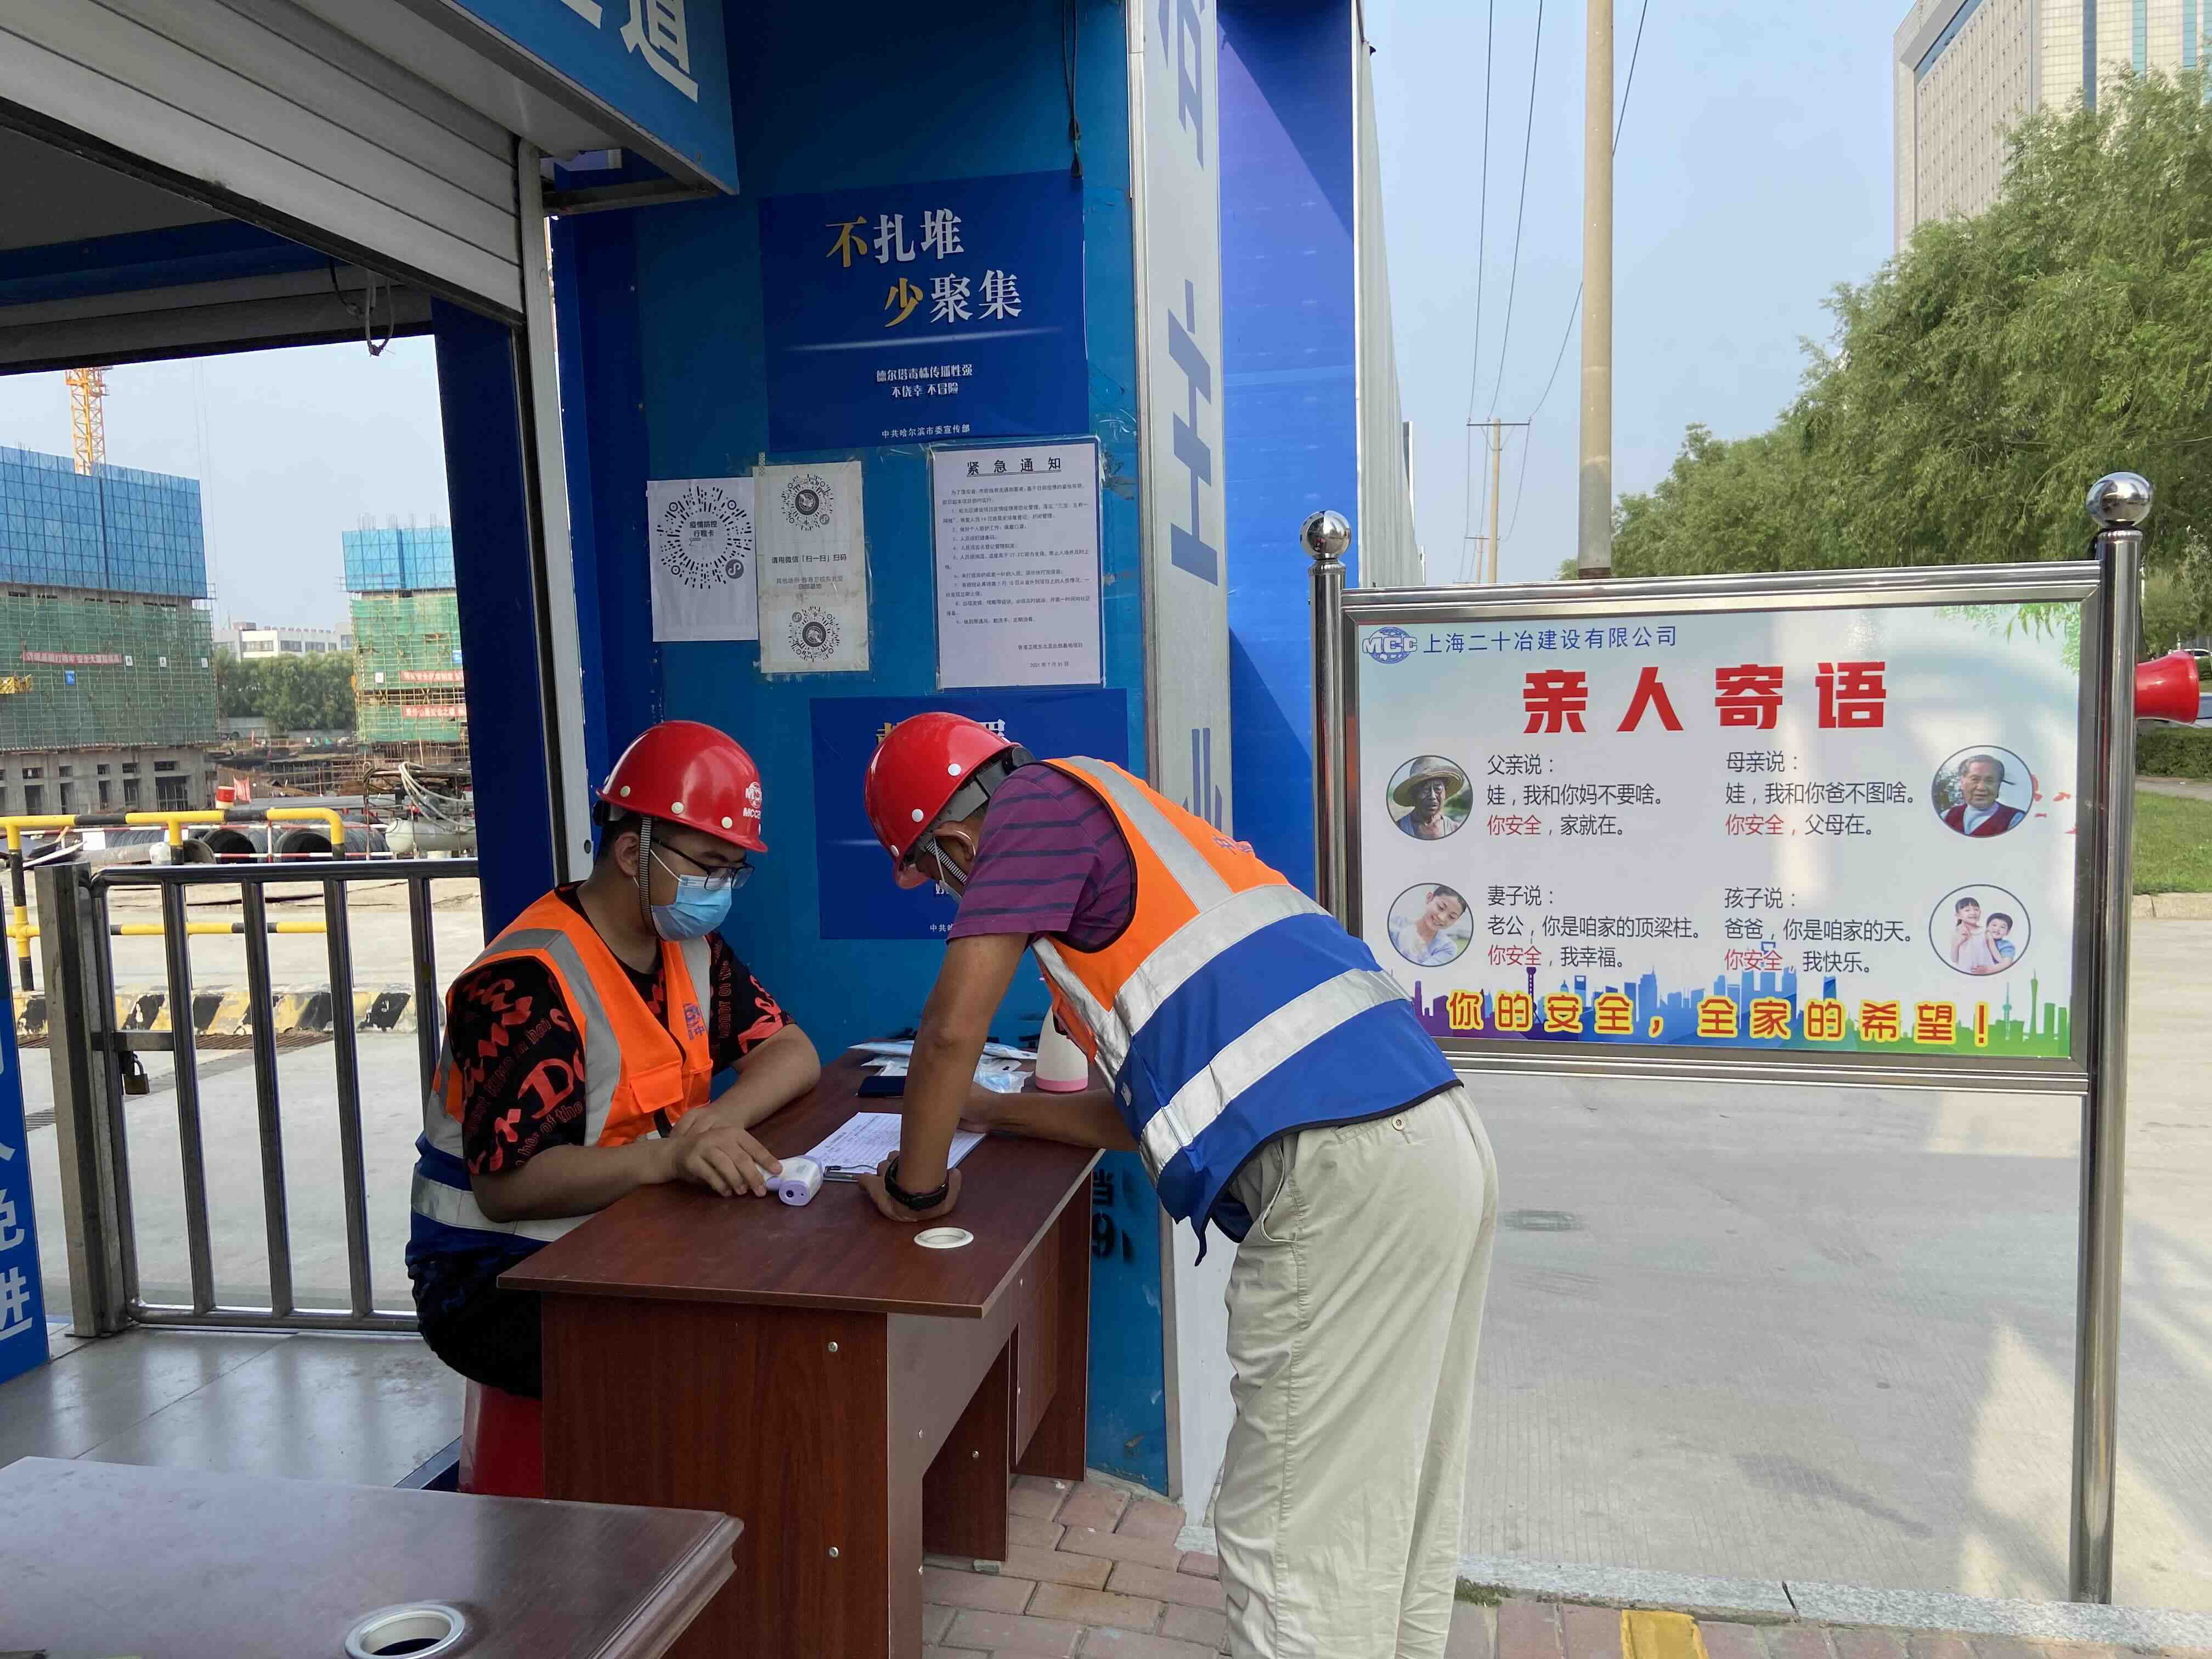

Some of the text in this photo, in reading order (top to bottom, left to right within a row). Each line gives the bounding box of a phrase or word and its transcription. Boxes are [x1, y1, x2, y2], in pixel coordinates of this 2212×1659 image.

[825, 208, 964, 268] 不扎堆
[884, 269, 1022, 328] 少聚集
[927, 383, 958, 395] 不冒险
[882, 424, 970, 438] 中共哈尔滨市委宣传部
[967, 457, 1061, 475] 紧急通知
[1362, 625, 1677, 654] MCC 上海二十冶建设有限公司
[1523, 661, 1887, 734] 亲人寄语
[1487, 754, 1554, 775] 父亲说：
[1725, 751, 1799, 773] 母亲说：
[1487, 784, 1663, 806] 娃，我和你妈不要啥。
[1725, 782, 1915, 805] 娃，我和你爸不图啥。
[1487, 814, 1624, 837] 你安全，家就在。
[1725, 813, 1873, 836] 你安全，父母在。
[1487, 885, 1554, 907] 妻子说：
[1725, 888, 1796, 910] 孩子说：
[1487, 915, 1699, 939] 老公，你是咱家的顶梁柱。
[1725, 919, 1912, 943] 爸爸，你是咱家的天。
[1487, 945, 1624, 968] 你安全，我幸福。
[1725, 949, 1871, 973] 你安全，我快乐。
[1446, 990, 1989, 1047] 你的安全，全家的希望！
